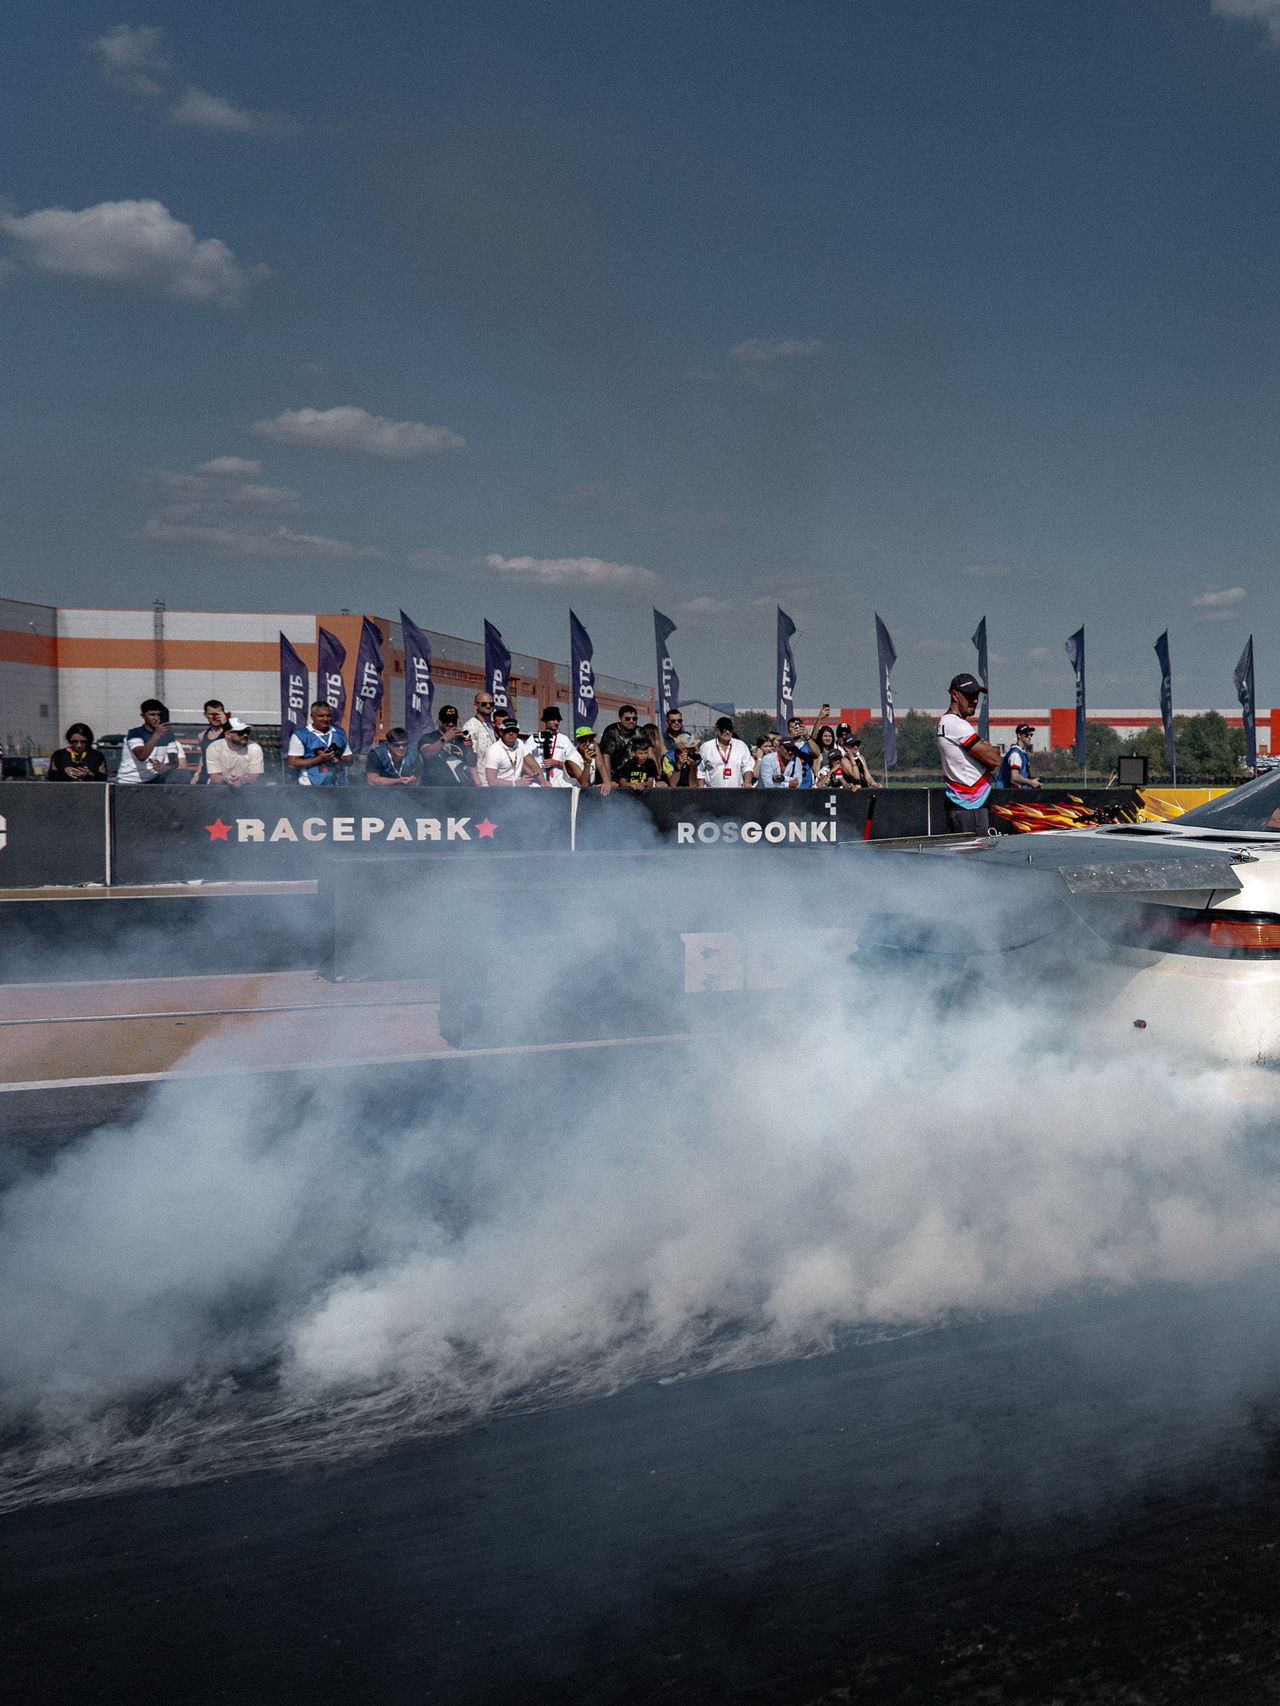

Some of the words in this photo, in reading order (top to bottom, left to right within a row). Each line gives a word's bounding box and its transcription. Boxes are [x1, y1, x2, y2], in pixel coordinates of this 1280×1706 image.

[289, 674, 304, 709] ВТБ
[326, 672, 342, 709] ВТБ
[361, 662, 379, 699] ВТБ
[413, 656, 430, 695] ВТБ
[492, 669, 508, 708] ВТБ
[579, 660, 595, 699] ВТБ
[235, 816, 472, 843] RACEPARK
